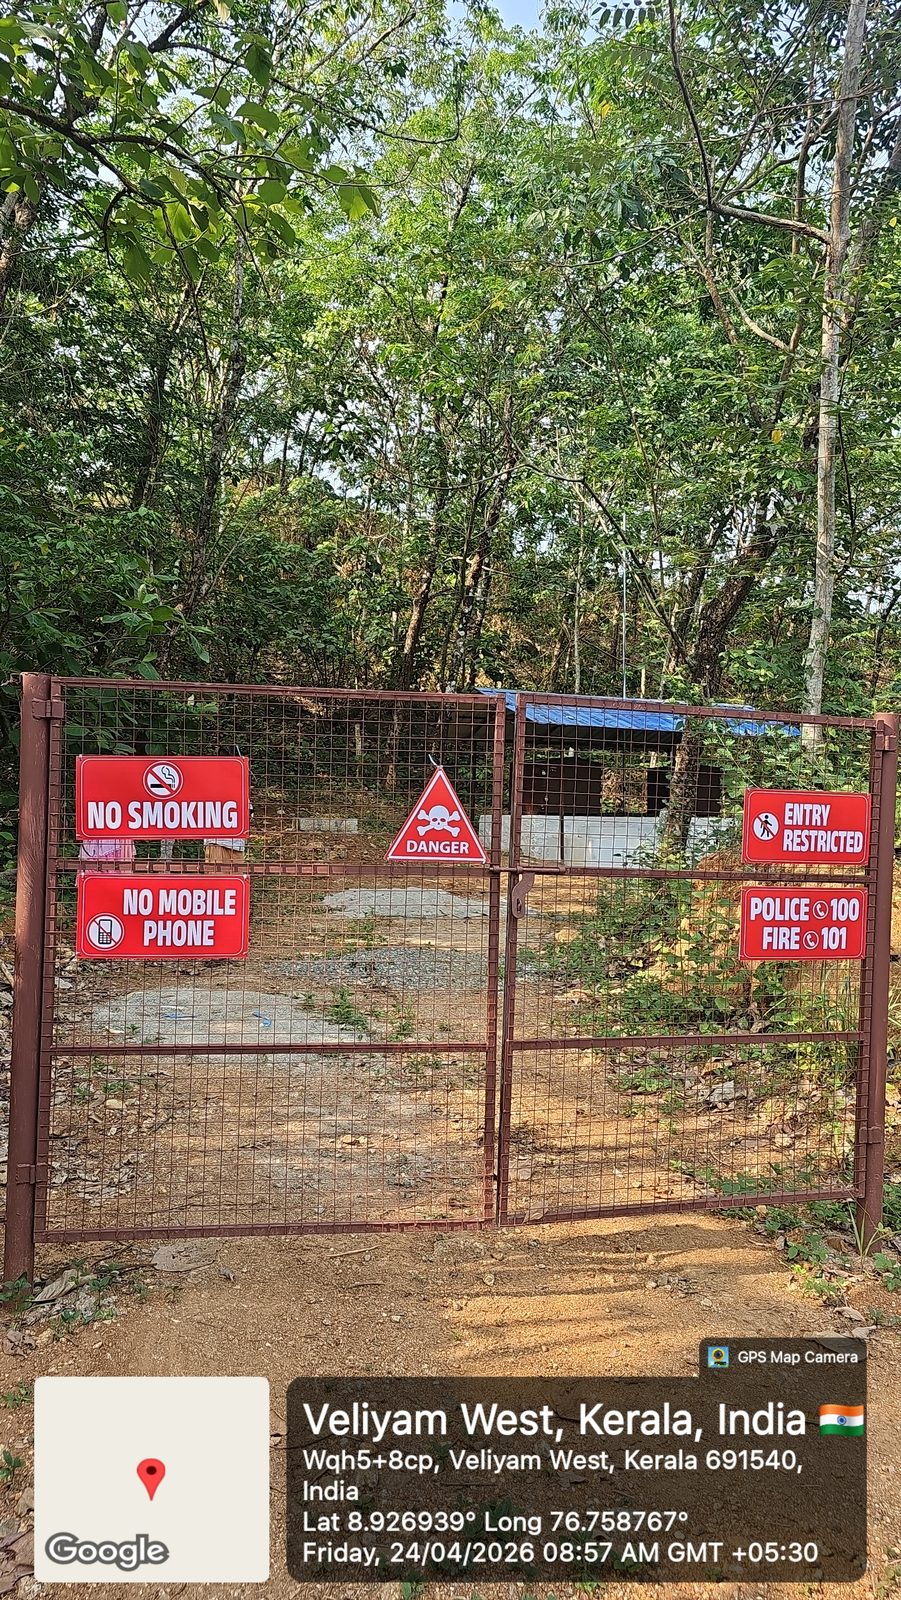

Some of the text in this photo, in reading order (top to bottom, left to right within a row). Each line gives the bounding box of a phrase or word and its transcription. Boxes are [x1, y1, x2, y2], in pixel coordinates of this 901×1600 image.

[88, 801, 238, 829] NO SMOKING
[784, 803, 831, 826] ENTRY
[406, 840, 469, 854] DANGER
[783, 829, 863, 853] RESTRICTED
[123, 888, 236, 916] NO MOBILE
[750, 897, 860, 922] POLICE 100
[143, 920, 215, 947] PHONE
[762, 926, 847, 950] FIRE 101
